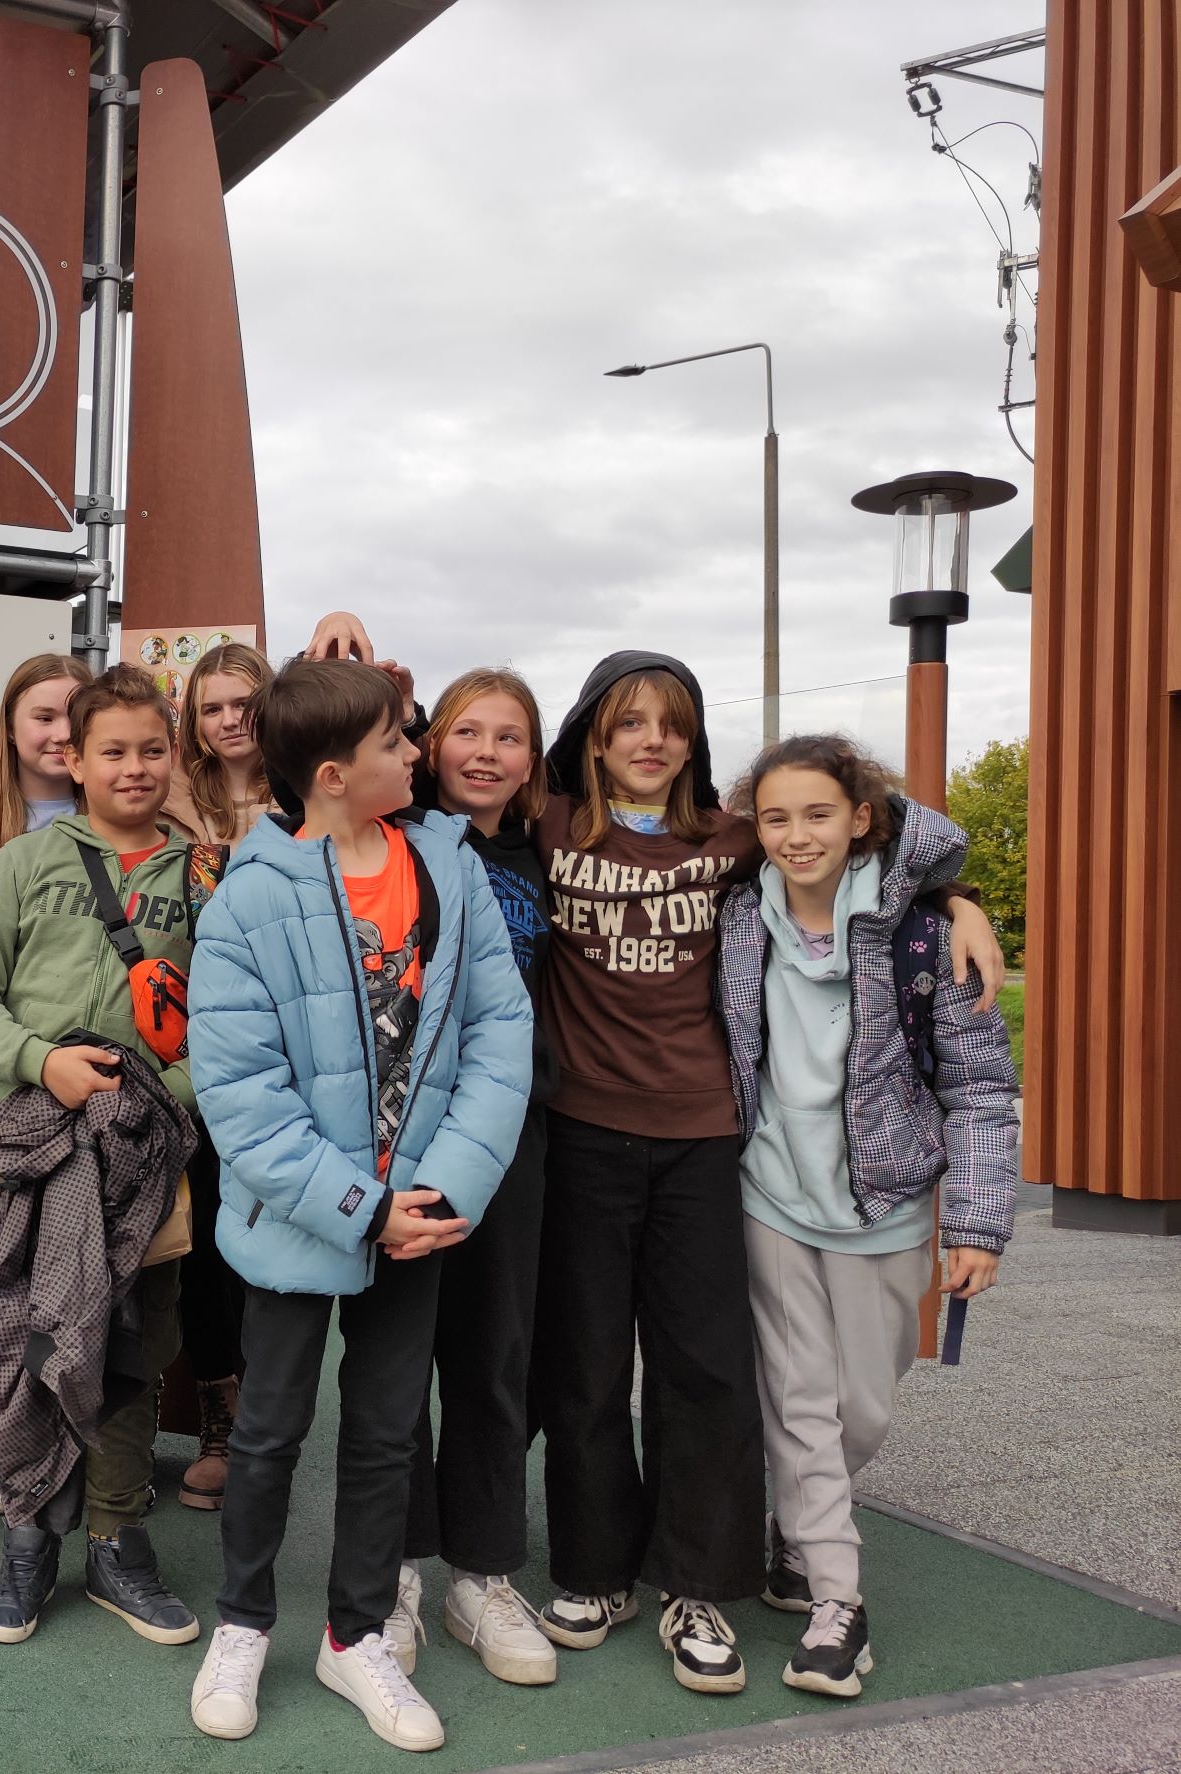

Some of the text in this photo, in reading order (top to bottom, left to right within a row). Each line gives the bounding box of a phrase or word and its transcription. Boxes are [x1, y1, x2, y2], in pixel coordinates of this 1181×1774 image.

[500, 898, 535, 932] ALE
[551, 891, 628, 937] NEW
[584, 936, 694, 973] EST. 1982 USA
